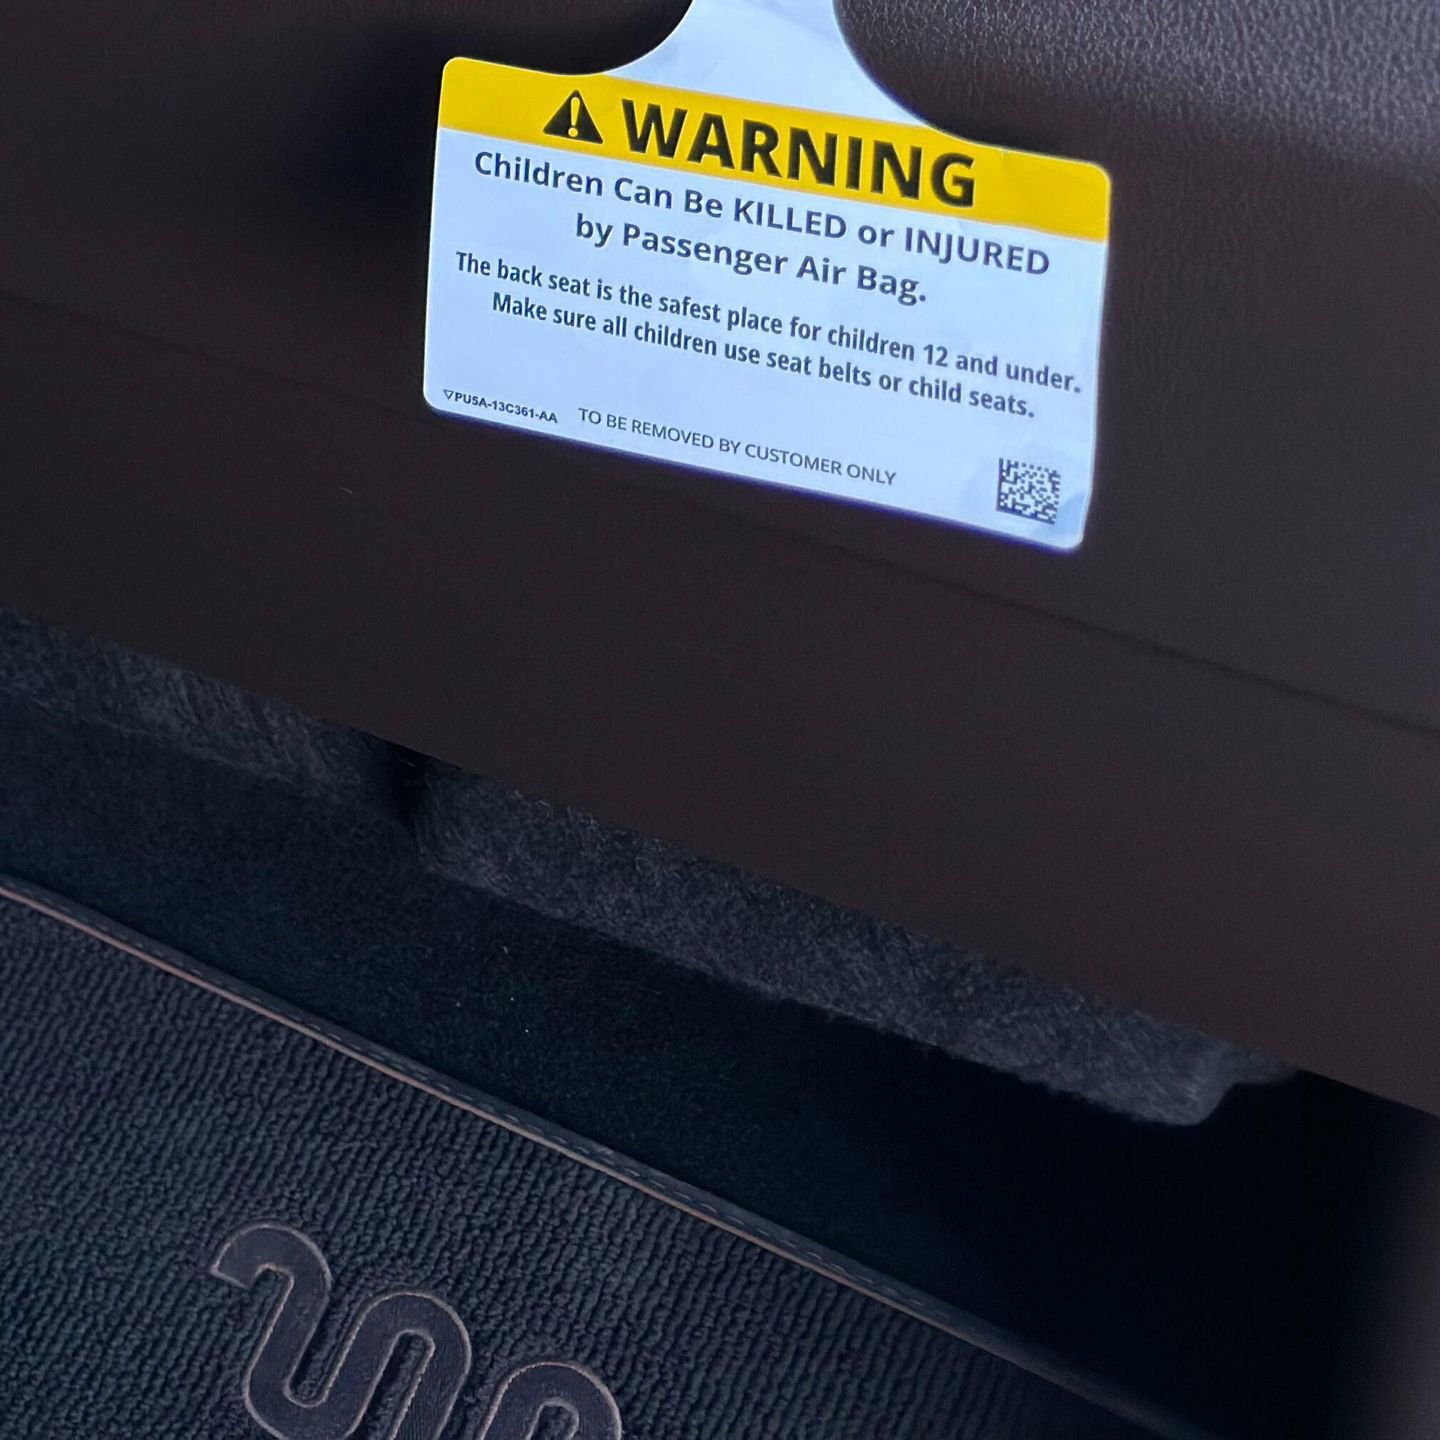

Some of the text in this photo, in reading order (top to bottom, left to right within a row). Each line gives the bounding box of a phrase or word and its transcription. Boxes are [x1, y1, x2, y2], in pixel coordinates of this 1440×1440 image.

[621, 98, 977, 208] WARNING
[474, 150, 1050, 276] Children Can Be KILLED or INJURED
[576, 212, 927, 307] by Passenger Air Bag.
[455, 251, 1081, 393] The back seat is the safest place for children 12 and under.
[492, 291, 1035, 418] Make sure all children use seat belts or child seats.
[578, 407, 897, 487] TO BE REMOVED BY CUSTOMER ONLY
